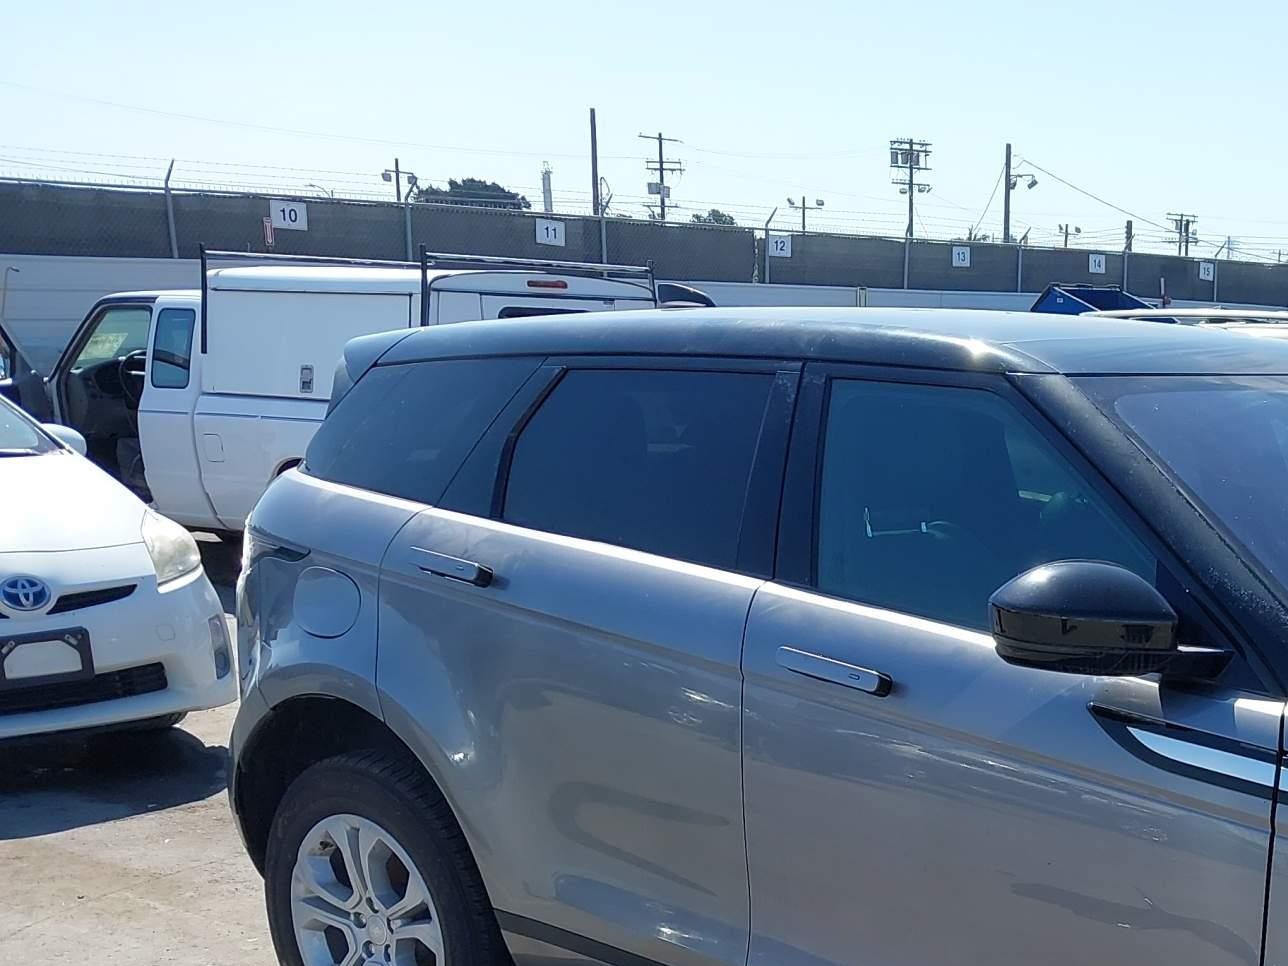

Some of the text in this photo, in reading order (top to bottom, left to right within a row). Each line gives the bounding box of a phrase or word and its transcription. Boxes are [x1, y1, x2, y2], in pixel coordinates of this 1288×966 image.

[279, 207, 298, 223] 10
[544, 226, 557, 240] 11
[774, 239, 786, 251] 12
[956, 251, 966, 262] 13
[1093, 259, 1102, 269] 14
[1203, 266, 1211, 277] 15
